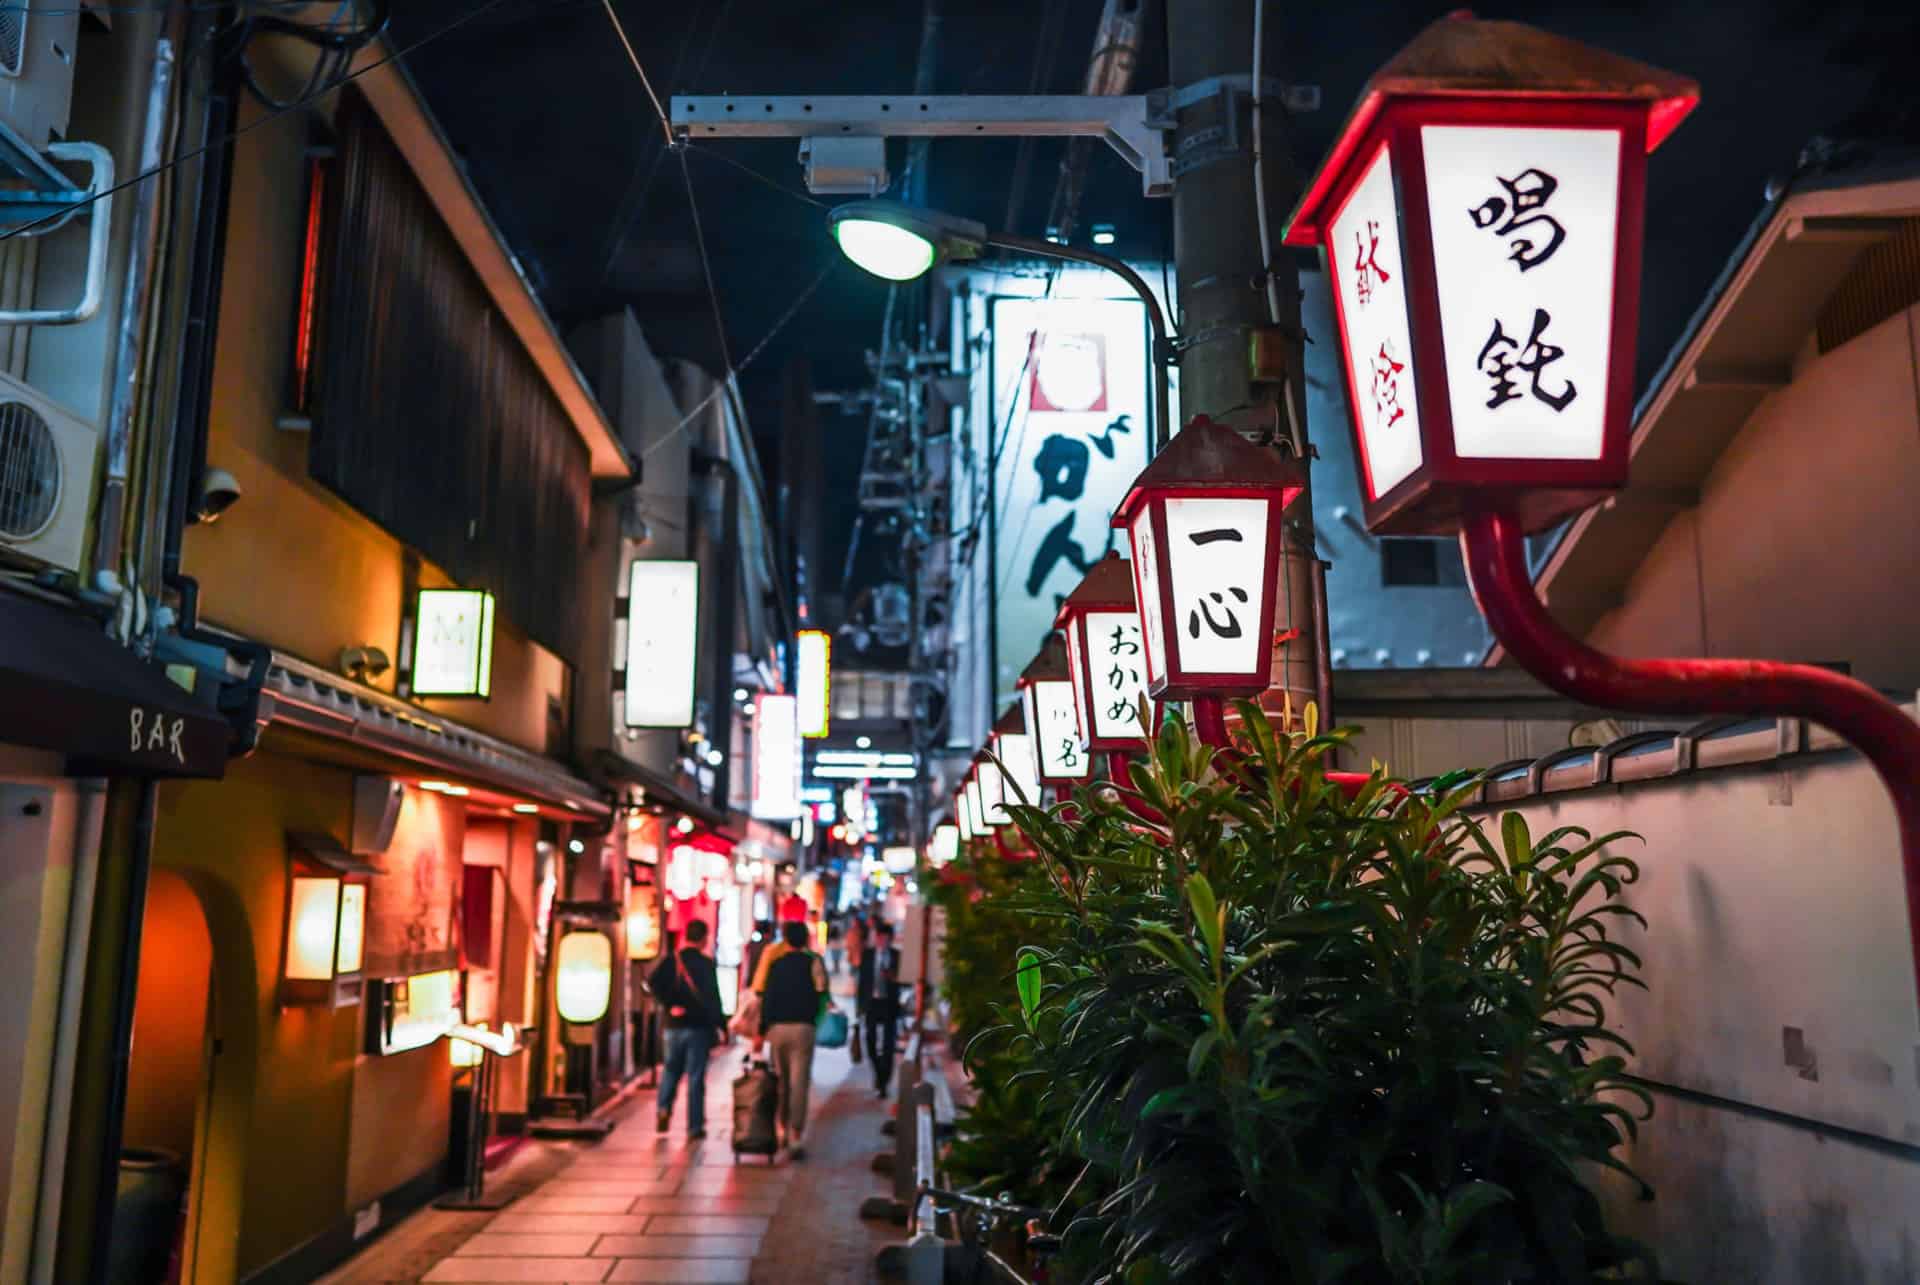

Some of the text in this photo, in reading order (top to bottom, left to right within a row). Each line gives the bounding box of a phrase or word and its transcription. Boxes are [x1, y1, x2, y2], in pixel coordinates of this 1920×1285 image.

[1189, 527, 1249, 640] 一心
[1107, 625, 1139, 724] おかめ
[130, 707, 185, 764] BAR
